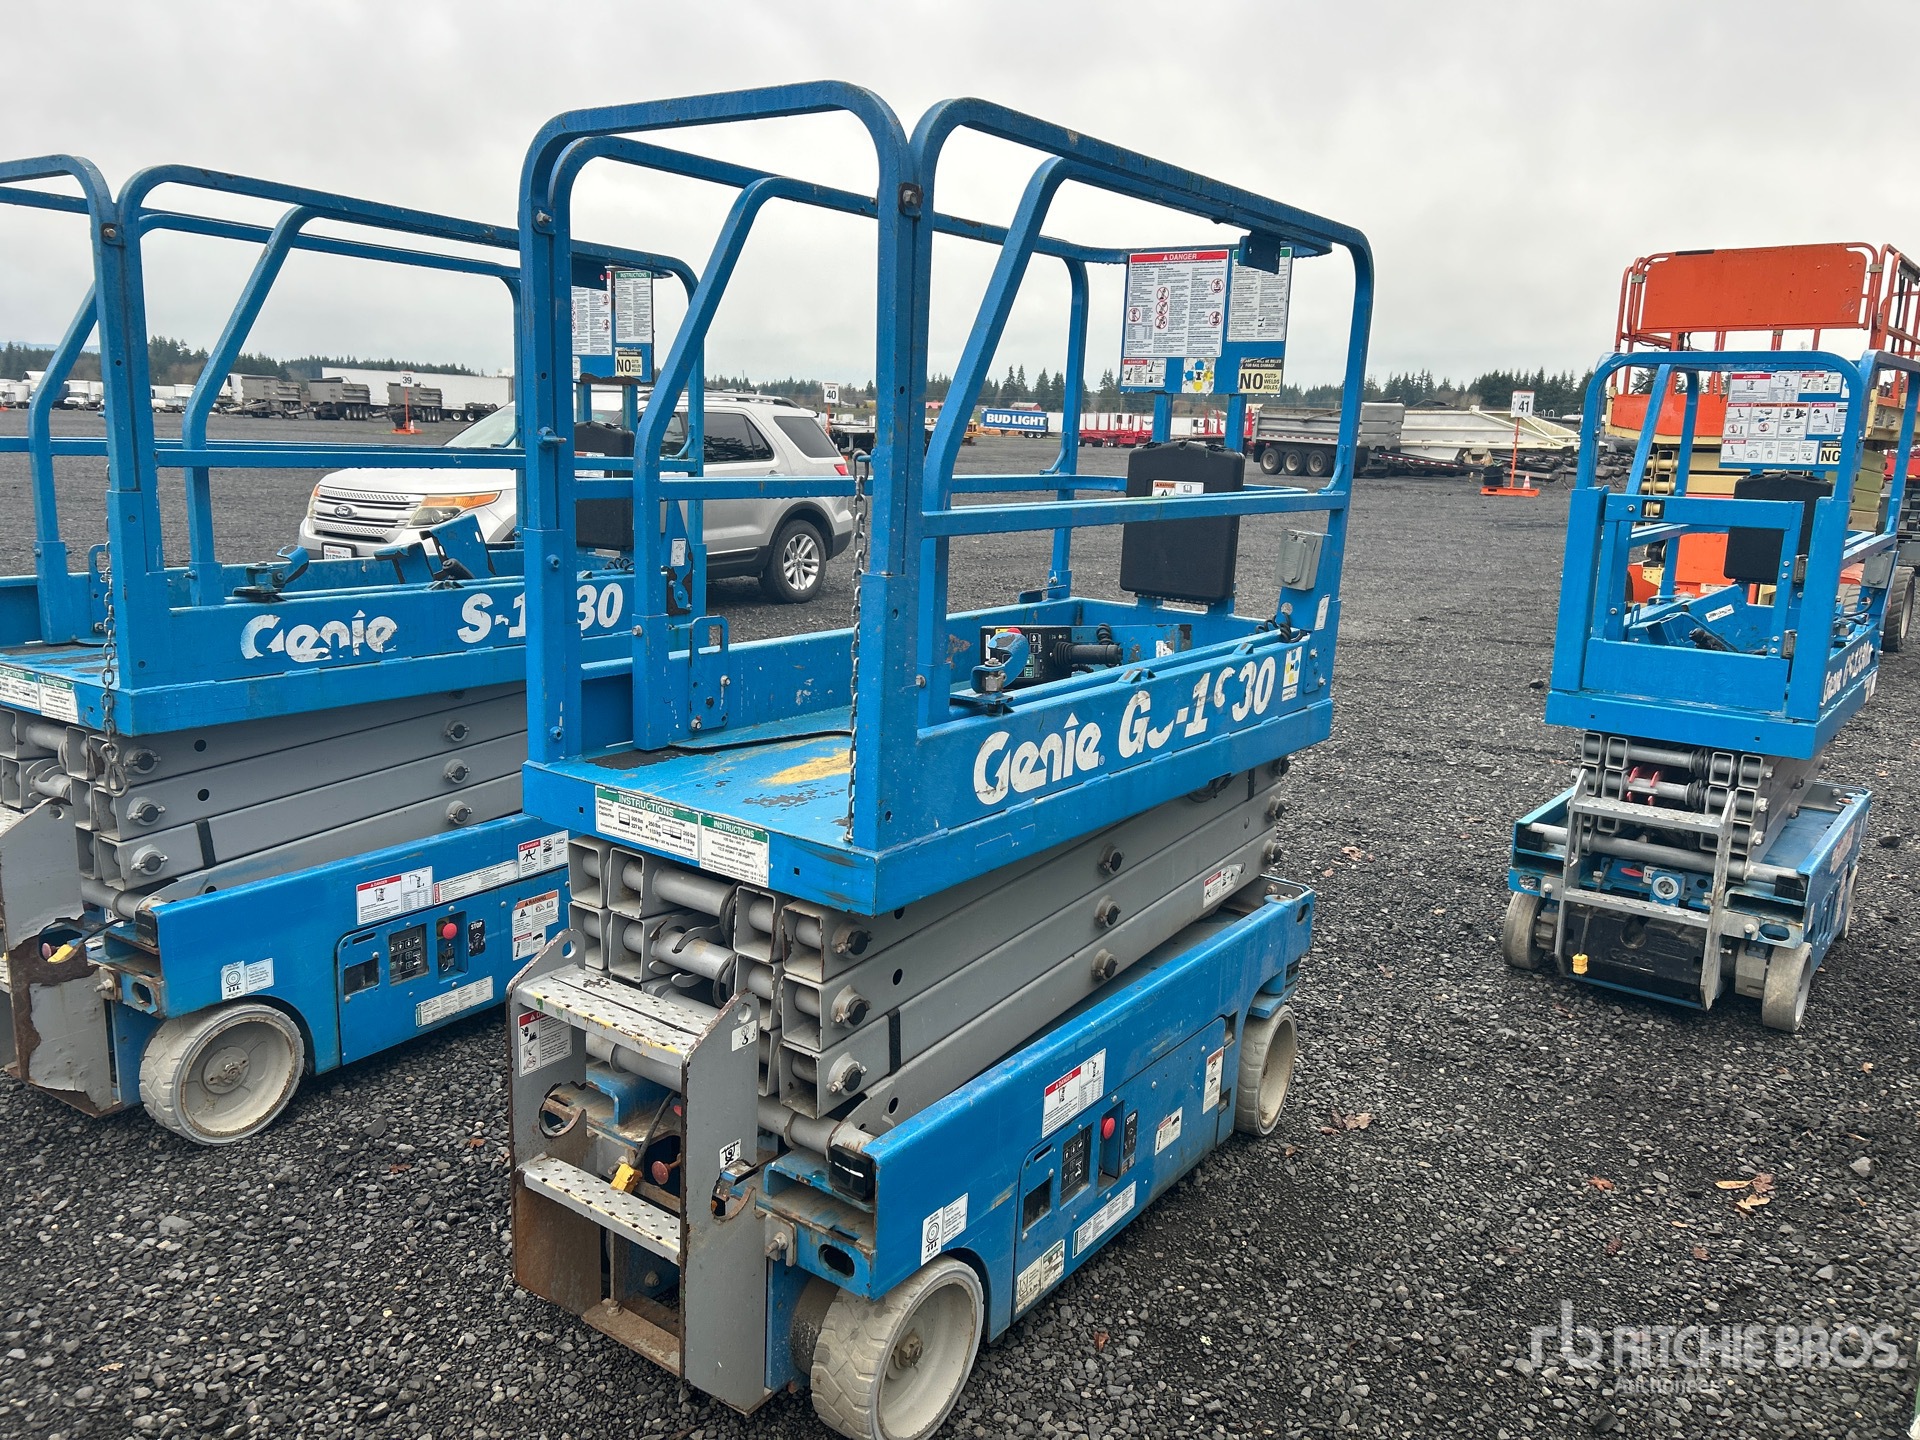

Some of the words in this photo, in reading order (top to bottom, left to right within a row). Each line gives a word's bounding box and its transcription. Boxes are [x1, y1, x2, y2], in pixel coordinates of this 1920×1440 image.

[1169, 253, 1197, 261] DANGER
[617, 359, 631, 372] NO
[1240, 373, 1263, 389] NO
[826, 390, 836, 399] 40
[1518, 401, 1530, 412] 41
[986, 414, 1011, 424] BUD
[1012, 415, 1046, 426] LIGHT
[457, 583, 623, 643] S-130
[240, 610, 398, 662] Genie
[974, 712, 1102, 804] Genie
[619, 794, 674, 816] INSTRUCTIONS
[714, 820, 754, 838] INSTRUCTIONS
[470, 922, 482, 930] STOP
[1127, 1113, 1136, 1125] STOP
